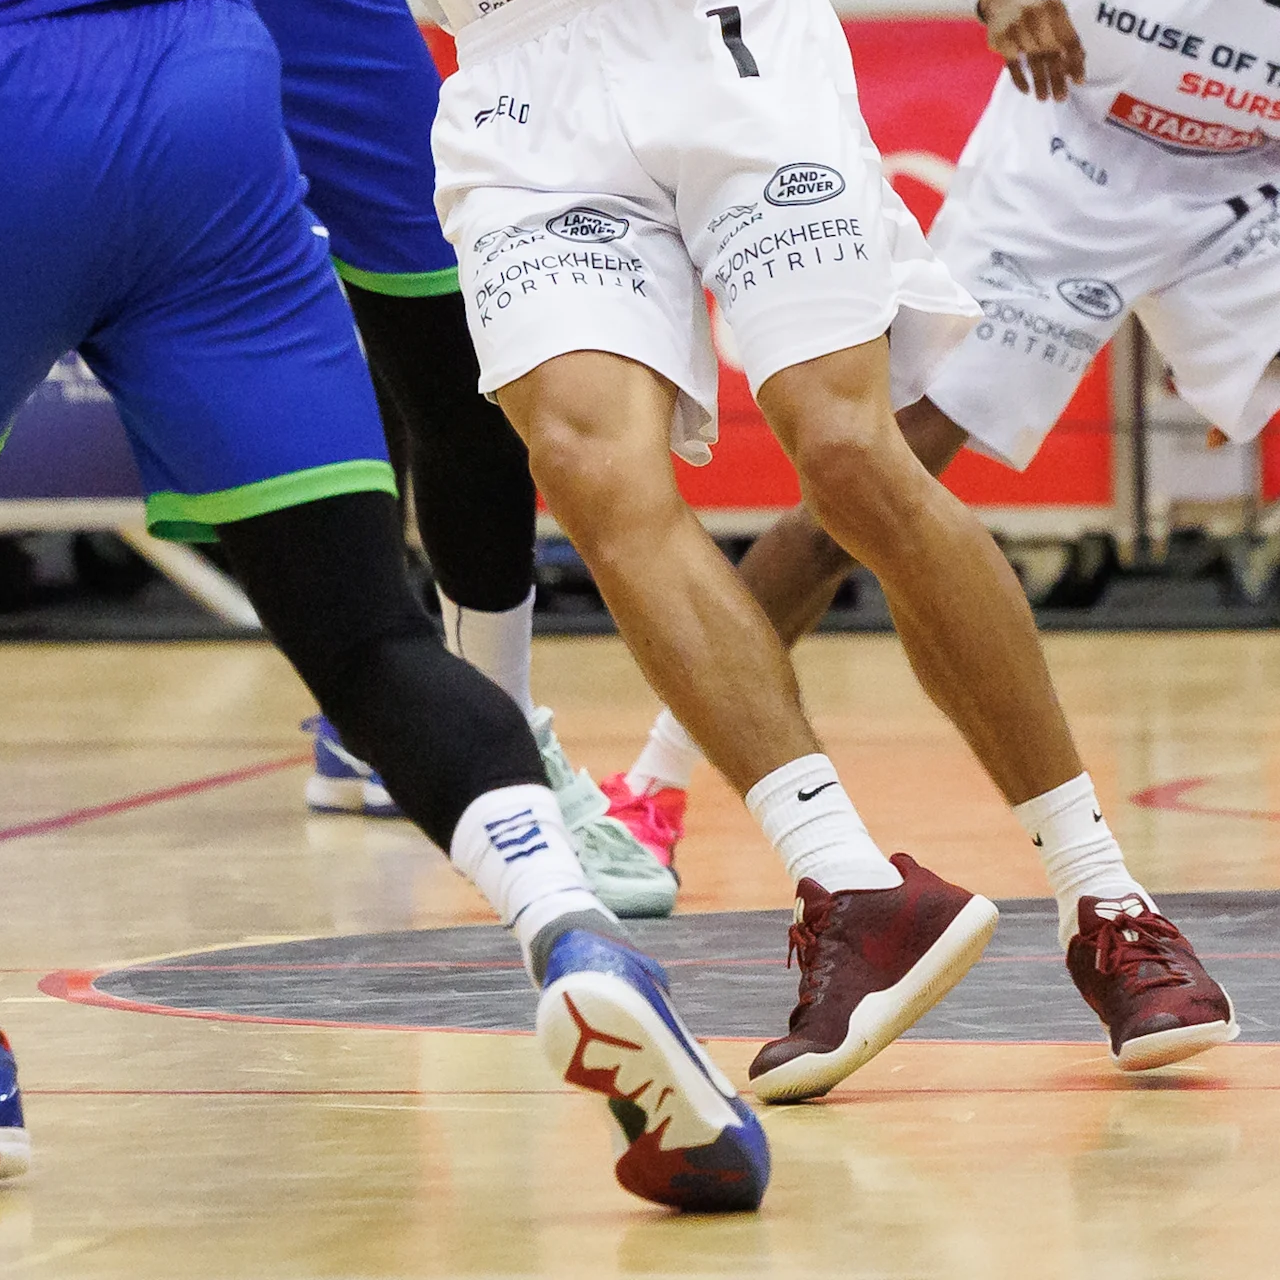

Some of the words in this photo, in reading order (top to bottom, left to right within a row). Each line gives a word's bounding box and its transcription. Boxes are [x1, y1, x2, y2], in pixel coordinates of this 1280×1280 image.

[706, 5, 761, 78] 1
[1097, 1, 1205, 60] HOUSE
[1211, 44, 1258, 73] OF
[728, 242, 869, 308] ORTRIJK
